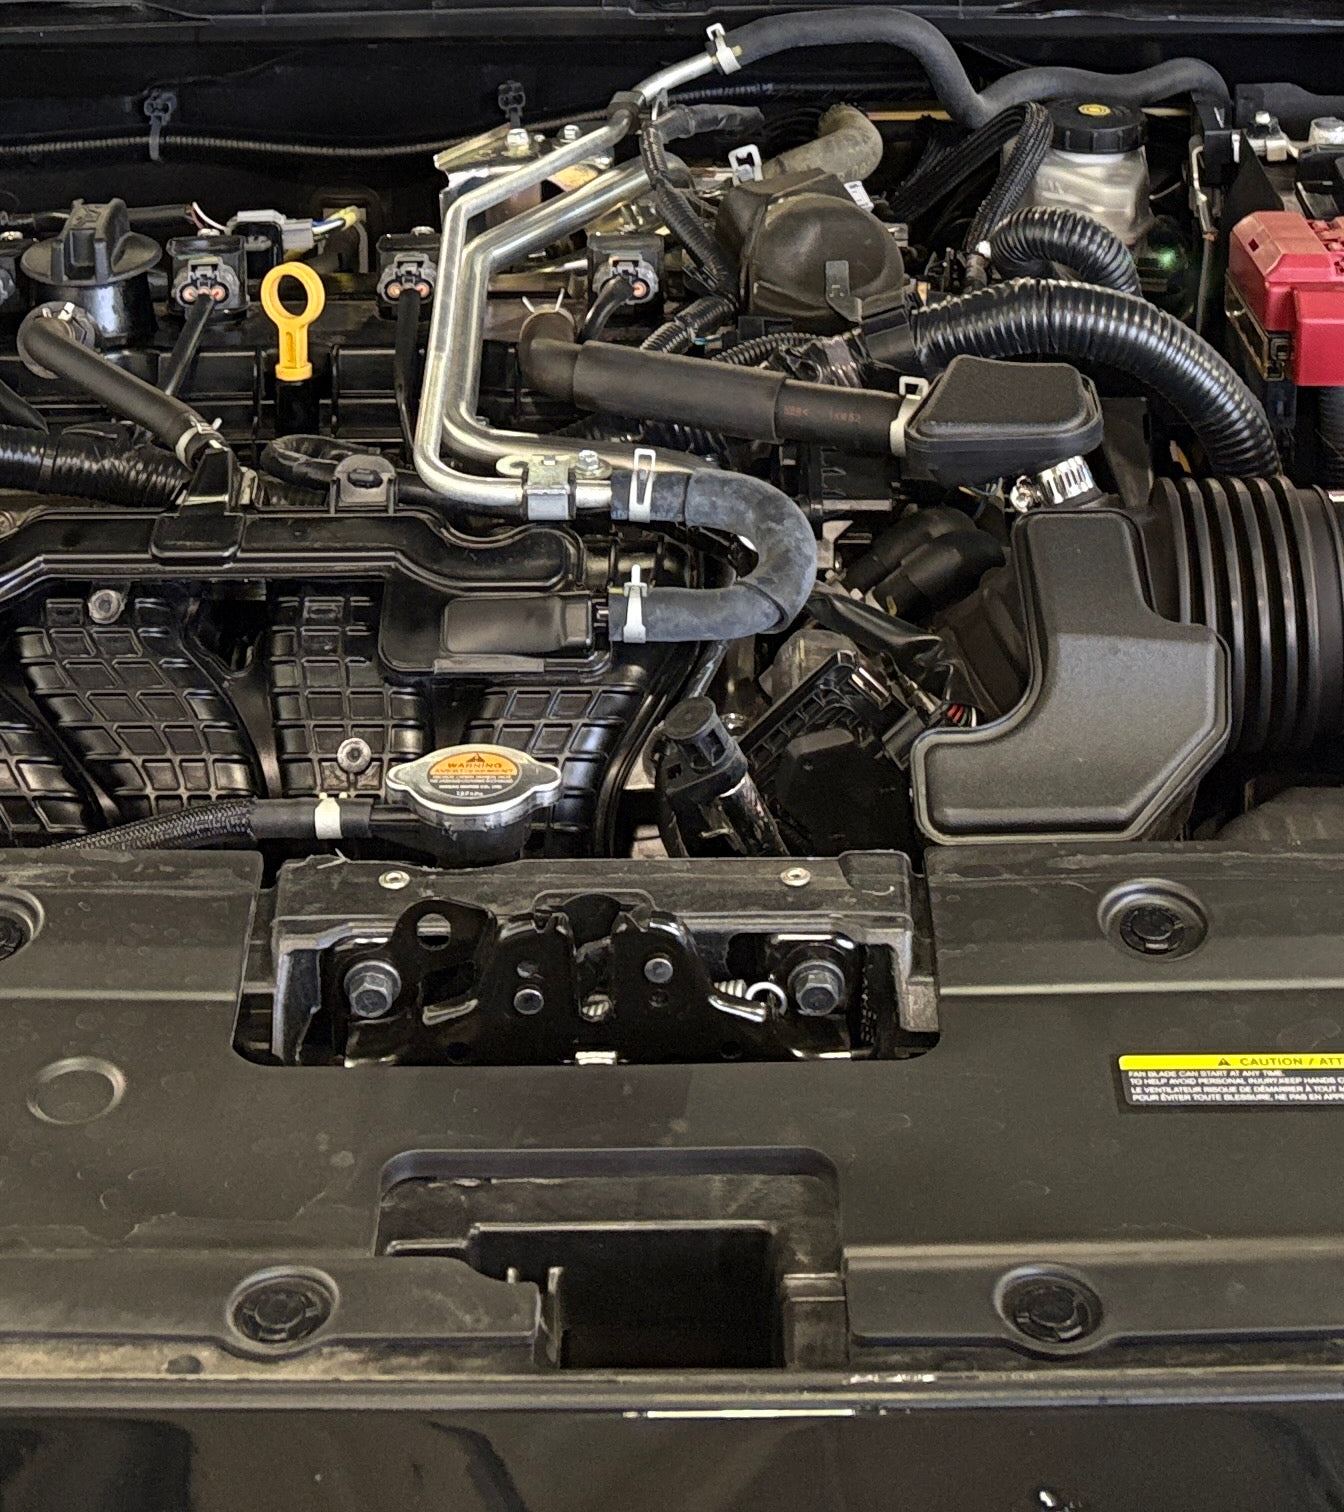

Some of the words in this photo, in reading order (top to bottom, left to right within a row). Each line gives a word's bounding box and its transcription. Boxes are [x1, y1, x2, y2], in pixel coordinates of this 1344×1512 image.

[1239, 1057, 1303, 1066] CAUTION
[1274, 1093, 1288, 1101] NE
[1288, 1093, 1307, 1101] PAS
